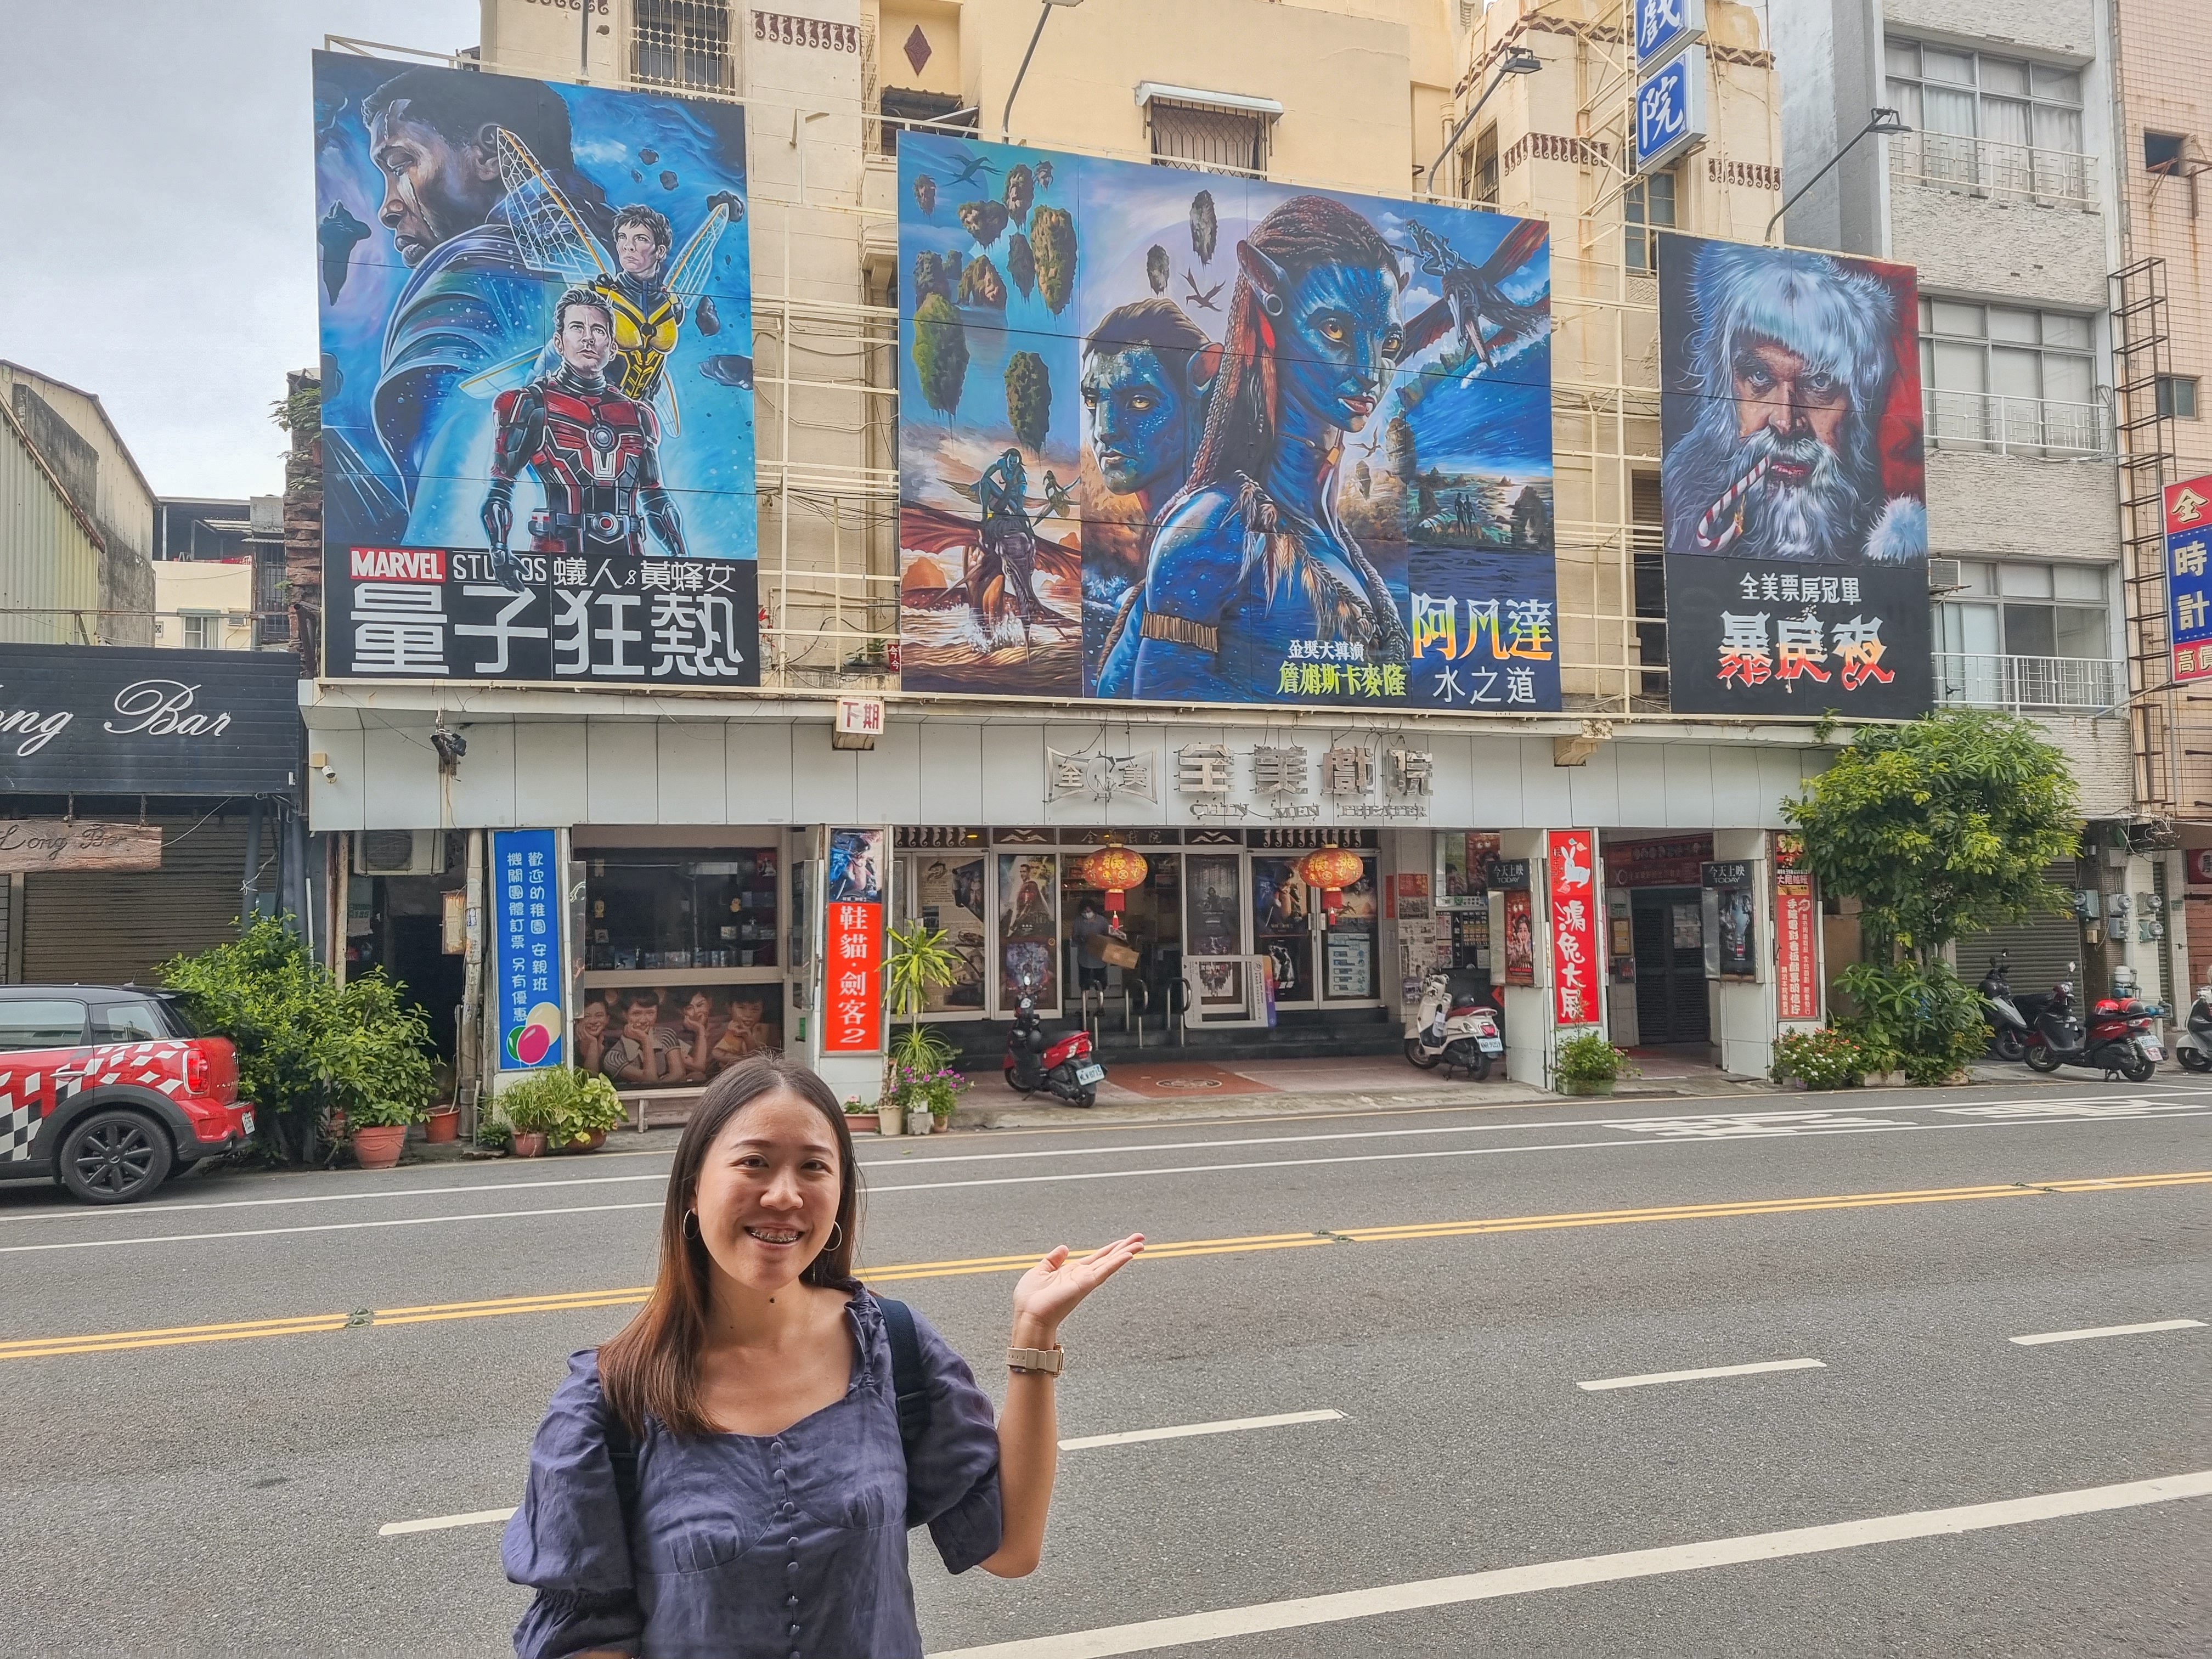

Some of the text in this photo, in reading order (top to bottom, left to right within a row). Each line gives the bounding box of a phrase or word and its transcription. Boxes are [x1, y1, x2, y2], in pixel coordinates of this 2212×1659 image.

[351, 550, 547, 582] MARVEL STUOS
[1740, 572, 1862, 605] 全美票房冠軍
[2175, 540, 2211, 631] 時計
[351, 583, 743, 676] 量子狂熱
[1411, 592, 1553, 661] 阿凡達
[1276, 660, 1408, 698] 詹姆斯卡麥隆
[1432, 665, 1536, 706] 水之道
[104, 679, 232, 737] Bar
[843, 702, 879, 730] 下期
[1178, 743, 1434, 796] 全美戲院
[0, 825, 68, 860] Long
[1493, 864, 1524, 878] 今天上映
[1709, 865, 1745, 878] 今天上映
[507, 851, 527, 1022] 機關團體訂票 另有優惠
[528, 851, 548, 992] 歡迎幼稚園 安親班
[1554, 899, 1587, 1019] 鴻兔大展
